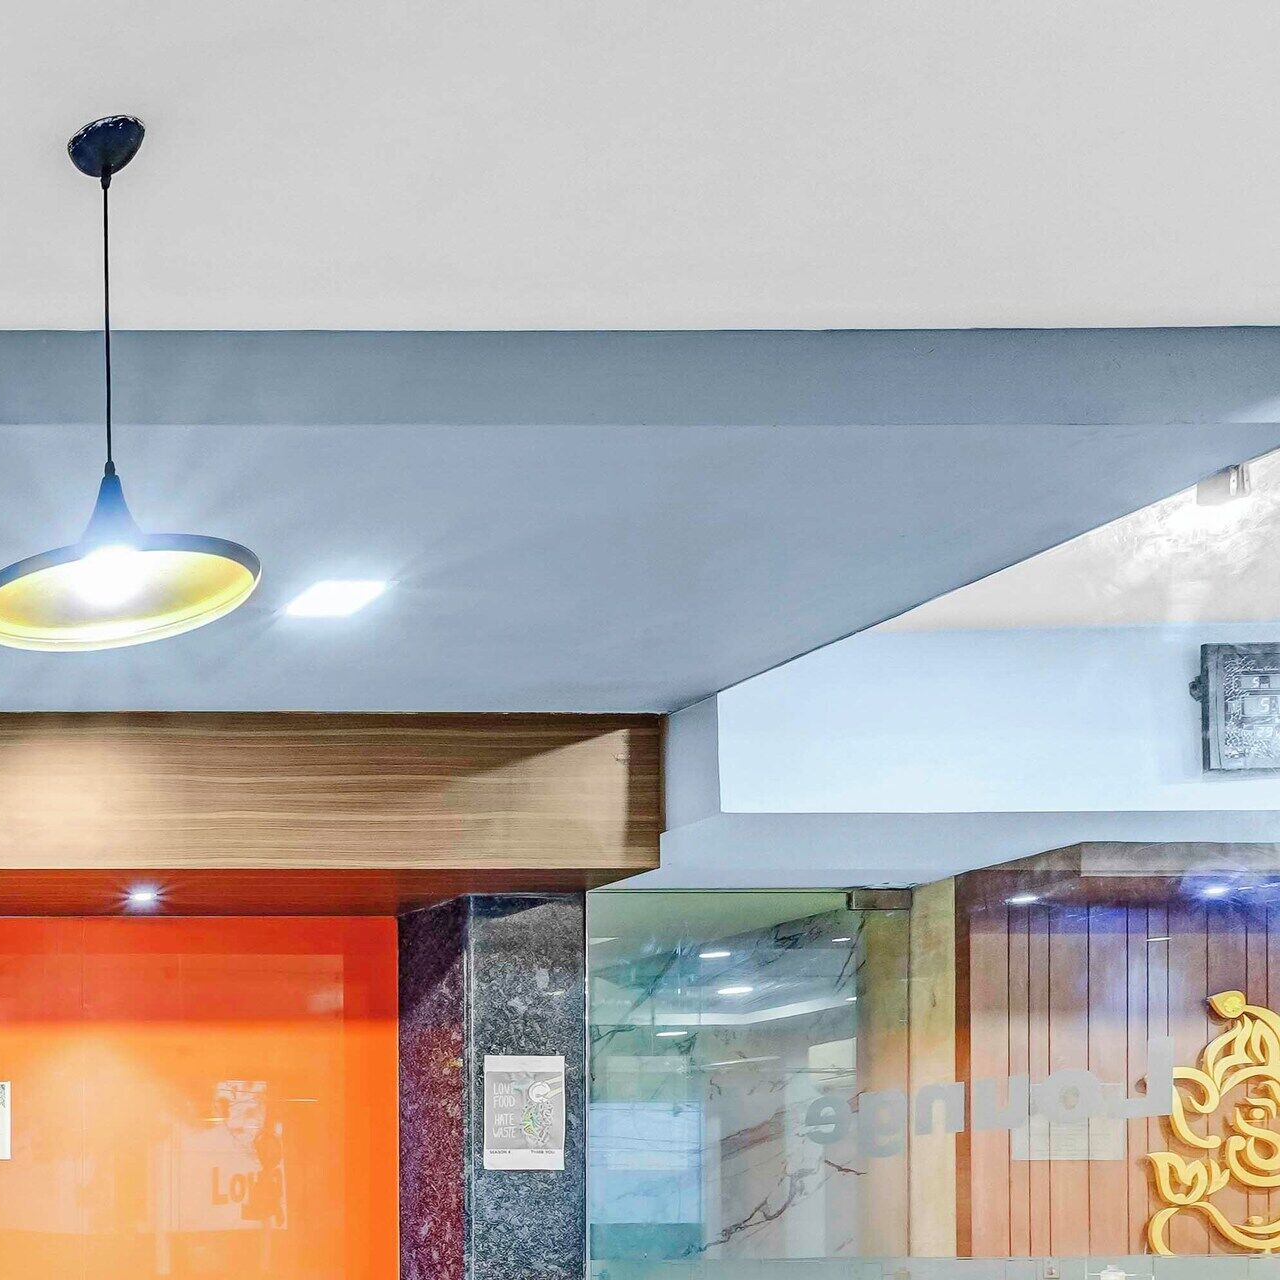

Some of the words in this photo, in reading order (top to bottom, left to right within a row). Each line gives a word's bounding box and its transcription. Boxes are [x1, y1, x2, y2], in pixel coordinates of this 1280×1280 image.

[493, 1095, 516, 1109] FOOD
[494, 1113, 516, 1126] HATE
[492, 1126, 517, 1138] WASTE
